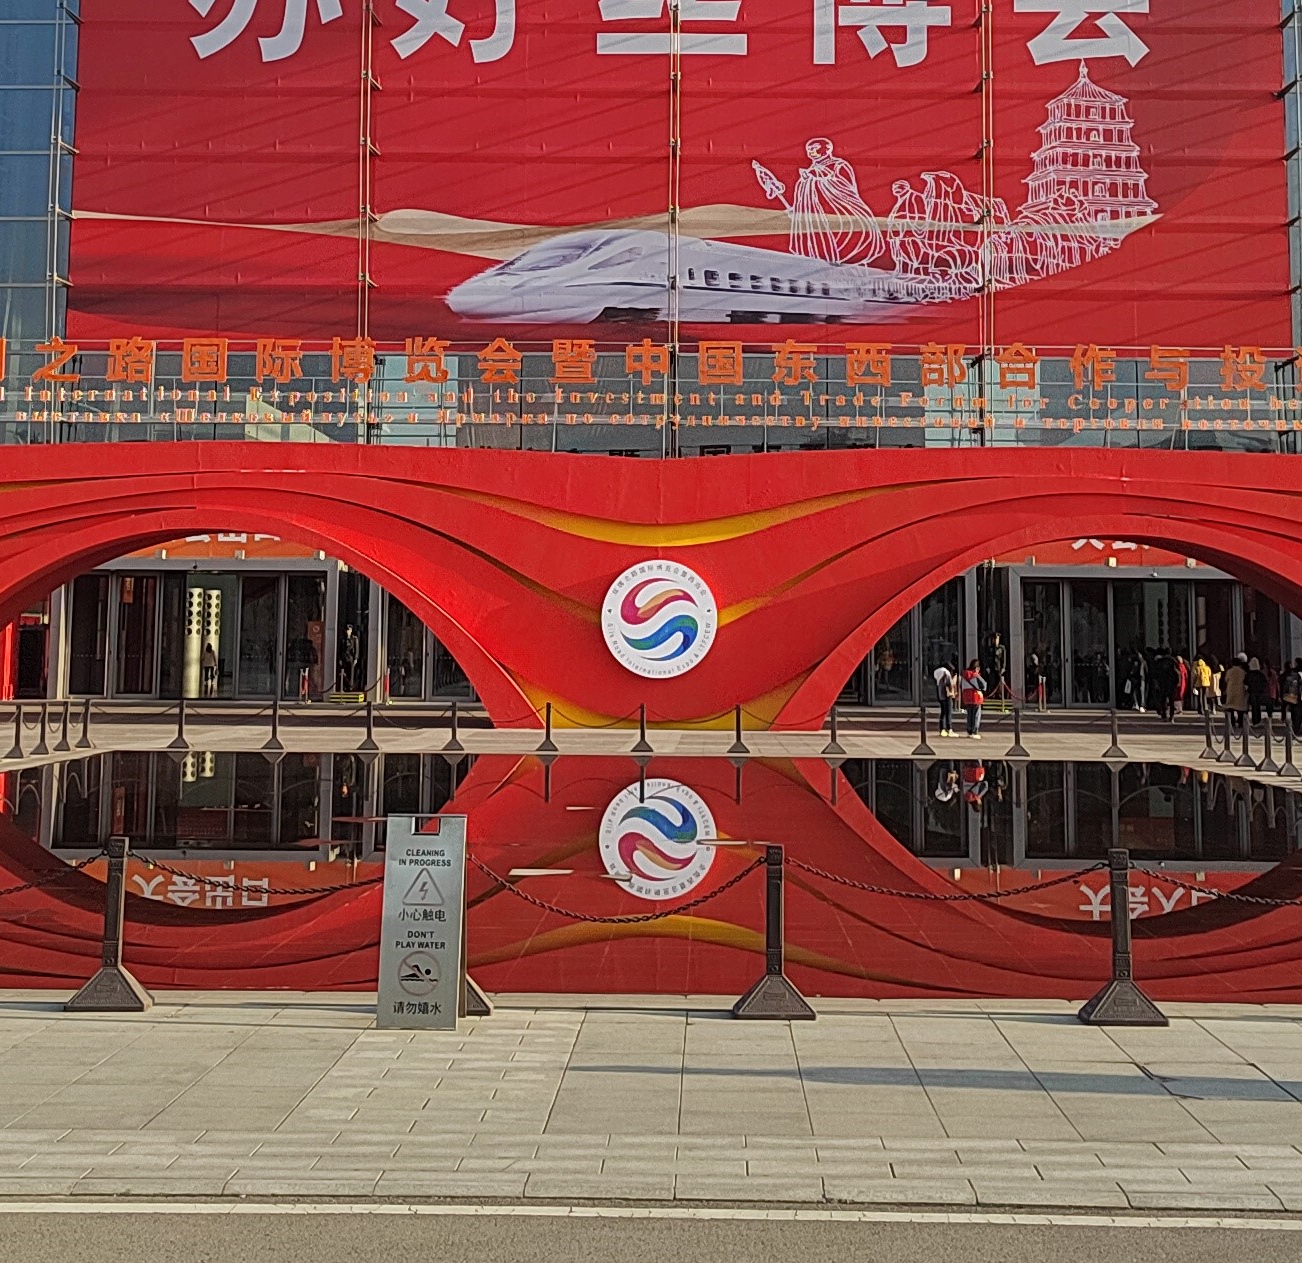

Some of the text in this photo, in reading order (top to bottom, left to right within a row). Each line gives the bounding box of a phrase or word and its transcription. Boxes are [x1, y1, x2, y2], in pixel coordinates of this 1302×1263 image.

[24, 385, 231, 403] International
[249, 386, 408, 406] Exposition
[427, 387, 474, 404] and
[494, 388, 536, 404] the
[555, 388, 716, 405] Investment
[735, 388, 782, 406] and
[800, 391, 881, 407] Trade
[899, 392, 987, 408] Forum
[1008, 393, 1049, 409] for
[405, 849, 445, 857] CLEANING
[409, 859, 452, 867] PROGRESS
[398, 908, 447, 922] 小心触电
[407, 930, 435, 939] DON'T
[395, 941, 446, 950] PLAY WATER
[393, 1000, 442, 1015] 请勿嬉水
